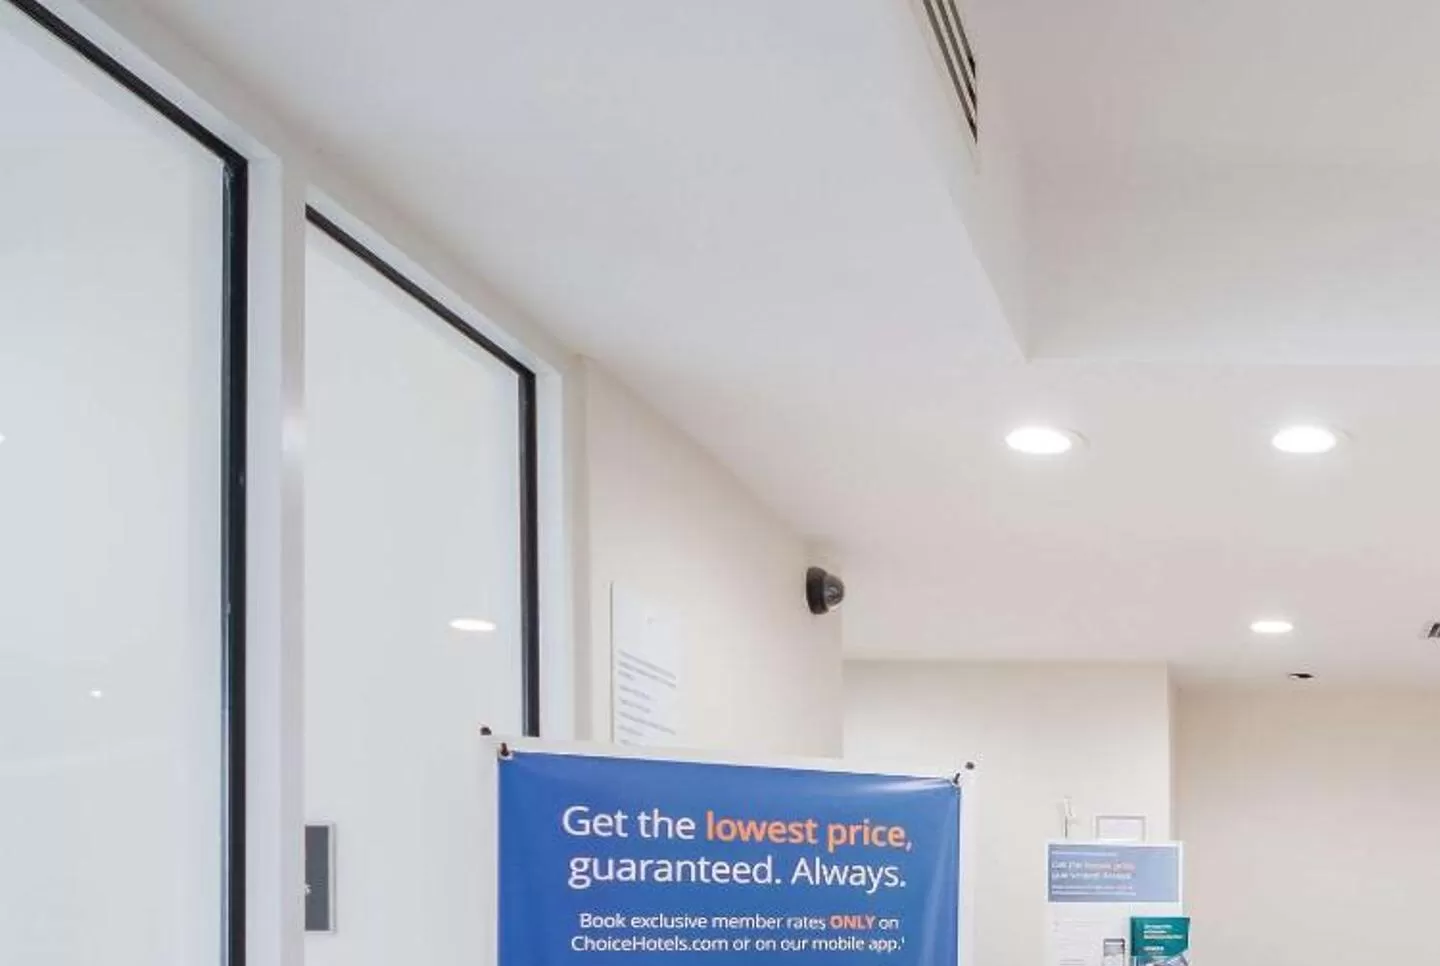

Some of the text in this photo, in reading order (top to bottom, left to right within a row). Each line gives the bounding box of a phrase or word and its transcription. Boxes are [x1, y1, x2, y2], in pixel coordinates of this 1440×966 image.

[562, 805, 913, 853] Get the lowest price,
[568, 854, 907, 894] guaranteed. Always.
[579, 912, 899, 930] Book exclusive member rates ONLY on
[571, 935, 728, 951] ChoiceHotels.com
[733, 938, 751, 951] or
[755, 938, 776, 951] on
[780, 938, 809, 951] our
[812, 935, 865, 951] mobile
